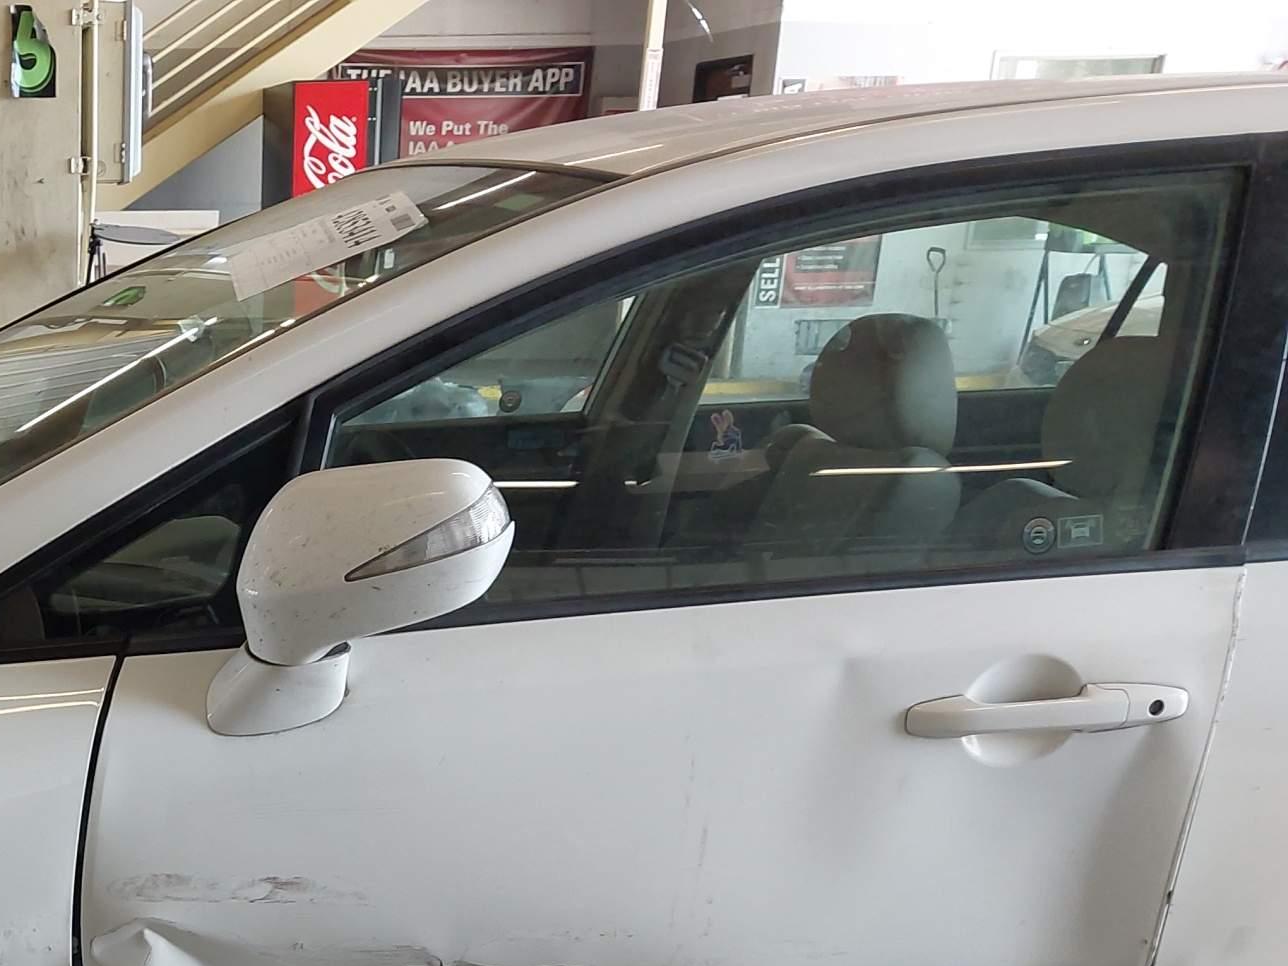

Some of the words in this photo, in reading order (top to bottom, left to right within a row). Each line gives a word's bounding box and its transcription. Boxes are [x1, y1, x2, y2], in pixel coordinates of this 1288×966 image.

[447, 68, 522, 93] BUYER
[527, 67, 575, 92] APP
[409, 121, 436, 136] We
[441, 120, 472, 136] Put
[477, 120, 509, 136] The
[759, 257, 781, 302] SELL
